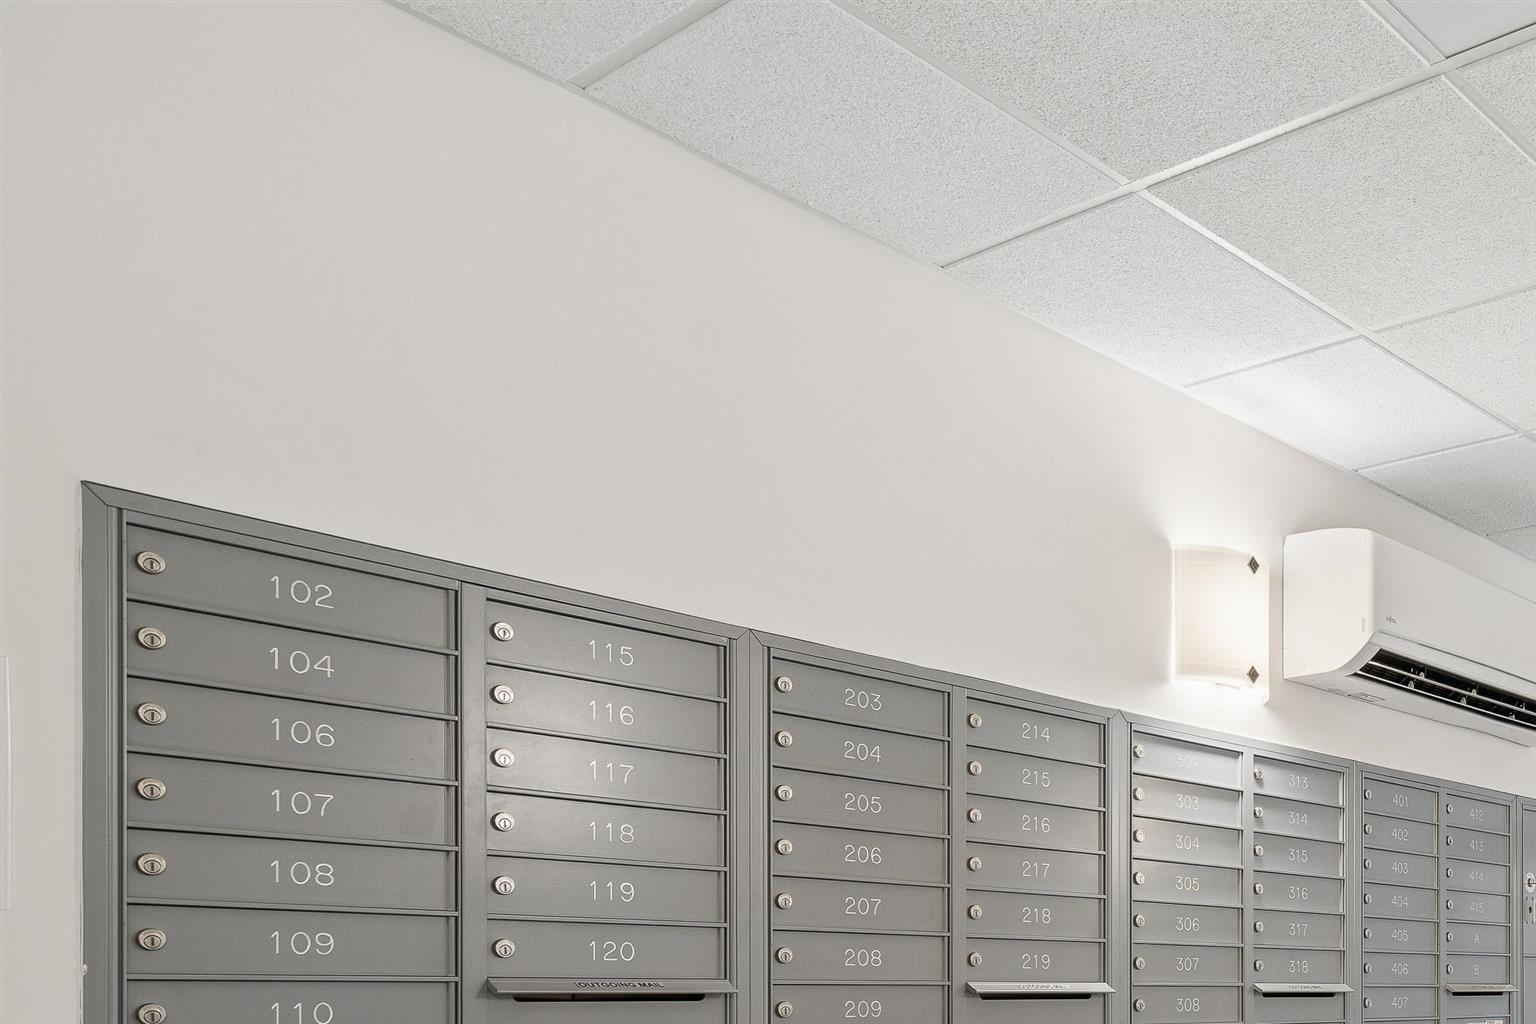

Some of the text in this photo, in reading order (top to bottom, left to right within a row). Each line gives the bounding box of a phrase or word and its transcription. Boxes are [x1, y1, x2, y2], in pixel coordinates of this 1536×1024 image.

[271, 576, 333, 608] 102
[590, 640, 633, 665] 115
[270, 648, 334, 677] 104
[845, 689, 881, 710] 203
[589, 701, 633, 725] 116
[272, 719, 334, 746] 106
[1022, 723, 1050, 742] 214
[845, 741, 881, 762] 204
[590, 761, 633, 784] 117
[1023, 769, 1050, 787] 215
[1289, 775, 1308, 789] 313
[272, 790, 333, 816] 107
[845, 793, 881, 813] 205
[1176, 794, 1199, 810] 303
[1393, 794, 1408, 807] 401
[1289, 811, 1307, 825] 314
[1470, 809, 1483, 821] 412
[1023, 815, 1050, 832] 216
[590, 822, 634, 843] 118
[1392, 829, 1408, 841] 402
[1176, 835, 1199, 850] 304
[1470, 840, 1483, 851] 413
[845, 845, 881, 864] 206
[1290, 849, 1307, 862] 315
[271, 861, 334, 885] 108
[1023, 861, 1049, 877] 217
[1392, 862, 1408, 874] 403
[1176, 876, 1199, 891] 305
[1470, 872, 1483, 881] 414
[591, 881, 634, 902] 119
[1289, 886, 1307, 899] 316
[846, 897, 881, 915] 207
[1392, 896, 1408, 907] 404
[1023, 907, 1050, 923] 218
[1176, 917, 1199, 931] 306
[1289, 923, 1307, 936] 317
[271, 932, 334, 954] 109
[1392, 929, 1408, 941] 405
[590, 941, 634, 961] 120
[845, 949, 881, 966] 208
[1023, 954, 1050, 969] 219
[1176, 958, 1199, 970] 307
[1289, 961, 1308, 973] 318
[1392, 963, 1408, 974] 406
[845, 1001, 881, 1017] 209
[1176, 998, 1200, 1012] 308
[1392, 997, 1408, 1008] 407
[272, 1002, 333, 1024] 110
